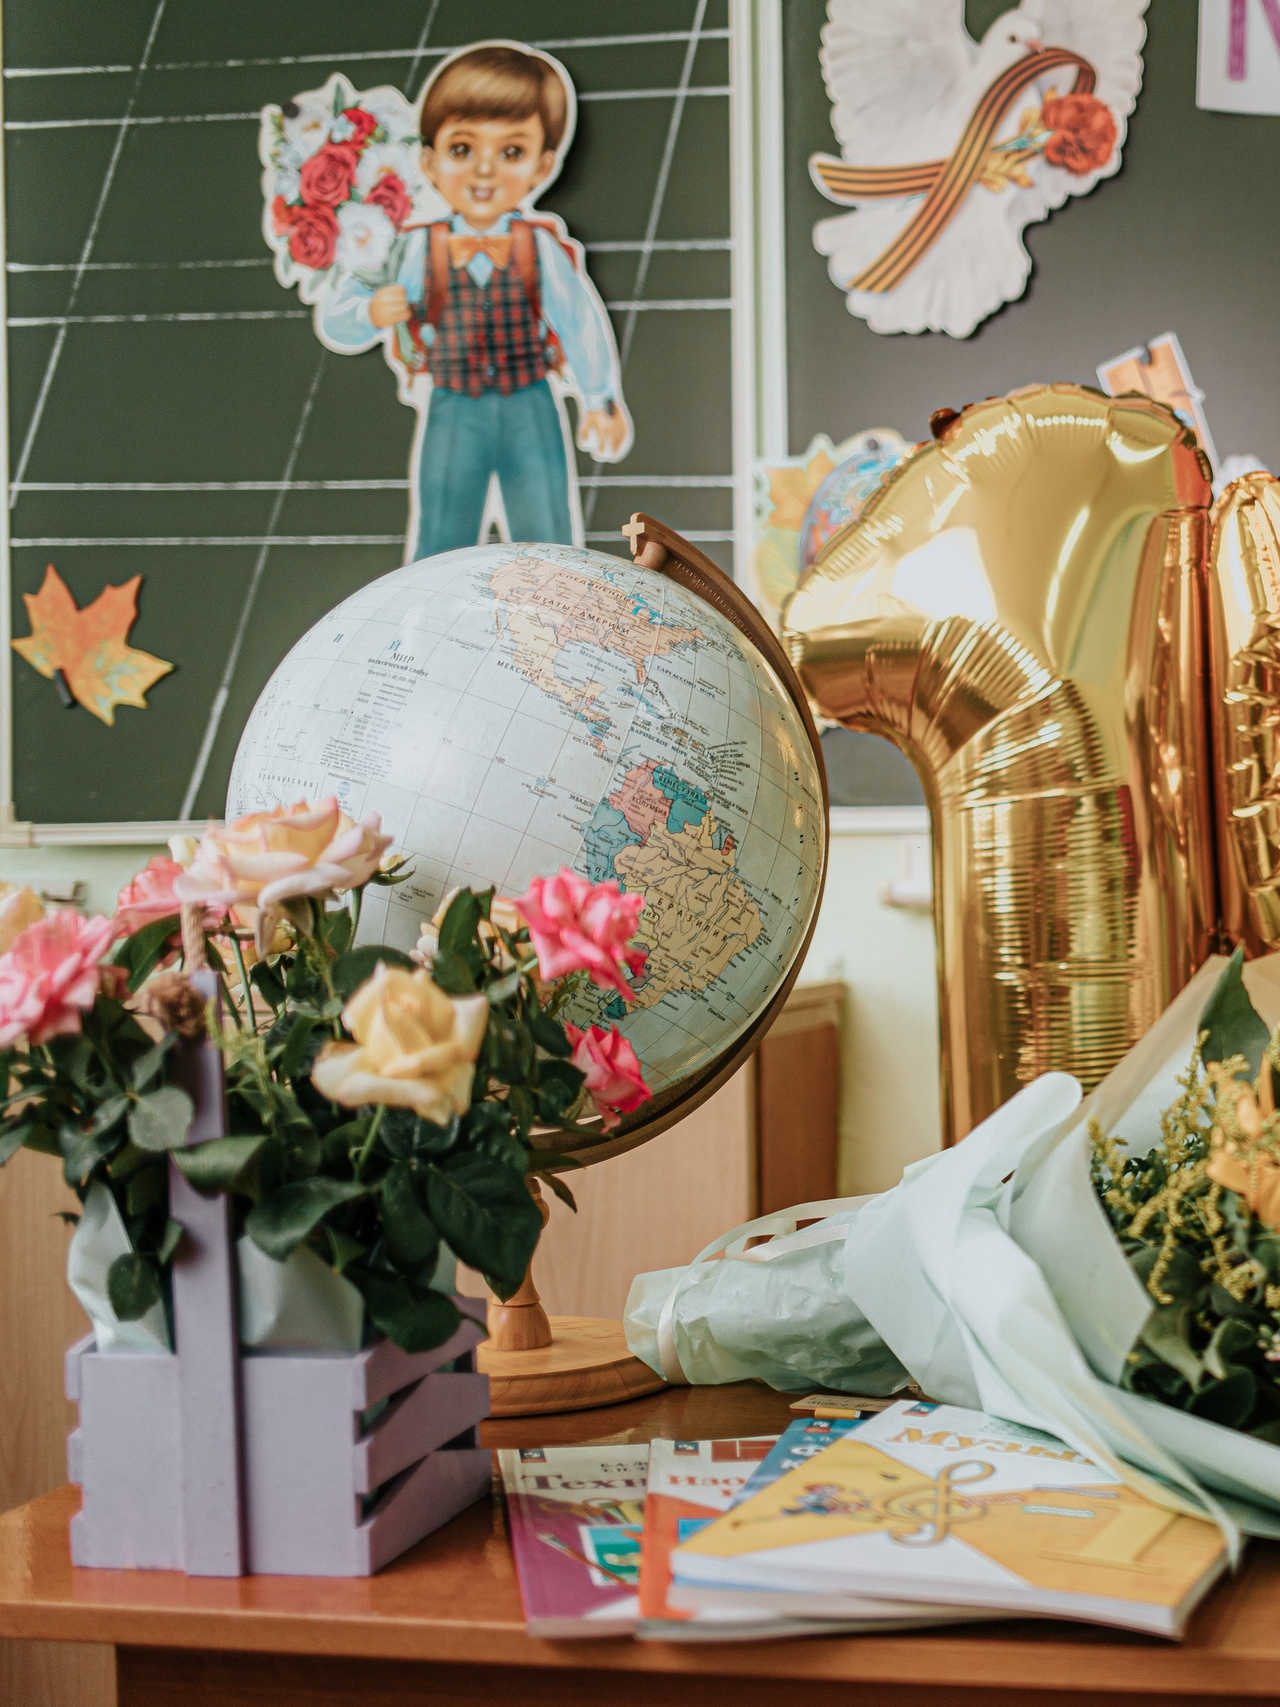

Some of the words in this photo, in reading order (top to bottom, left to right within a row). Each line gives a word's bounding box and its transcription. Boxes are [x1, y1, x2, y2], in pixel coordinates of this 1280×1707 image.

[580, 611, 630, 635] АМЕРИКИ
[390, 652, 415, 663] МИР
[496, 660, 541, 681] МЕКСИКА
[494, 755, 506, 765] 100
[658, 773, 700, 801] ВЕНЕСУЭЛА
[568, 793, 595, 807] ЭКВАДОР
[631, 795, 668, 817] КОЛУМБИЯ
[657, 898, 728, 942] БРАЗИЛИЯ
